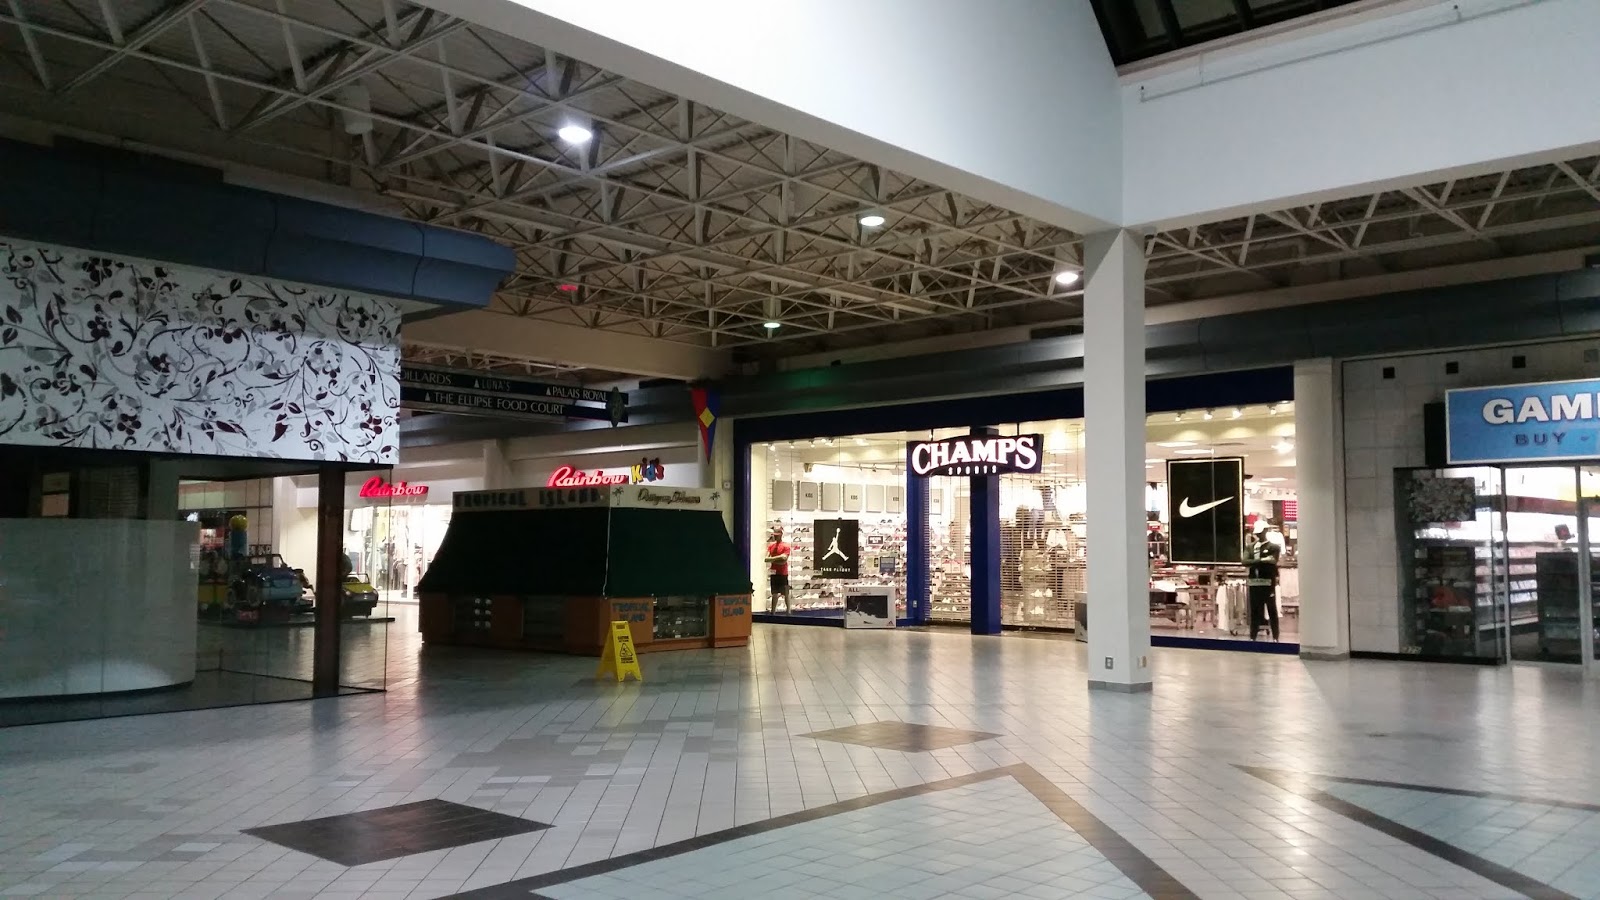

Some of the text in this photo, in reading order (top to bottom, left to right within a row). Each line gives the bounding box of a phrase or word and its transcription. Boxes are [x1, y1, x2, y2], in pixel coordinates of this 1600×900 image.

[435, 391, 564, 415] THE ELLIPSE FOOD COURT
[552, 385, 608, 402] PALAIS ROYAL
[1482, 392, 1600, 425] GAM
[1515, 432, 1567, 446] BUY
[911, 437, 1037, 475] CHAMPS
[359, 475, 428, 497] Rainbow
[545, 464, 629, 488] Rainbow
